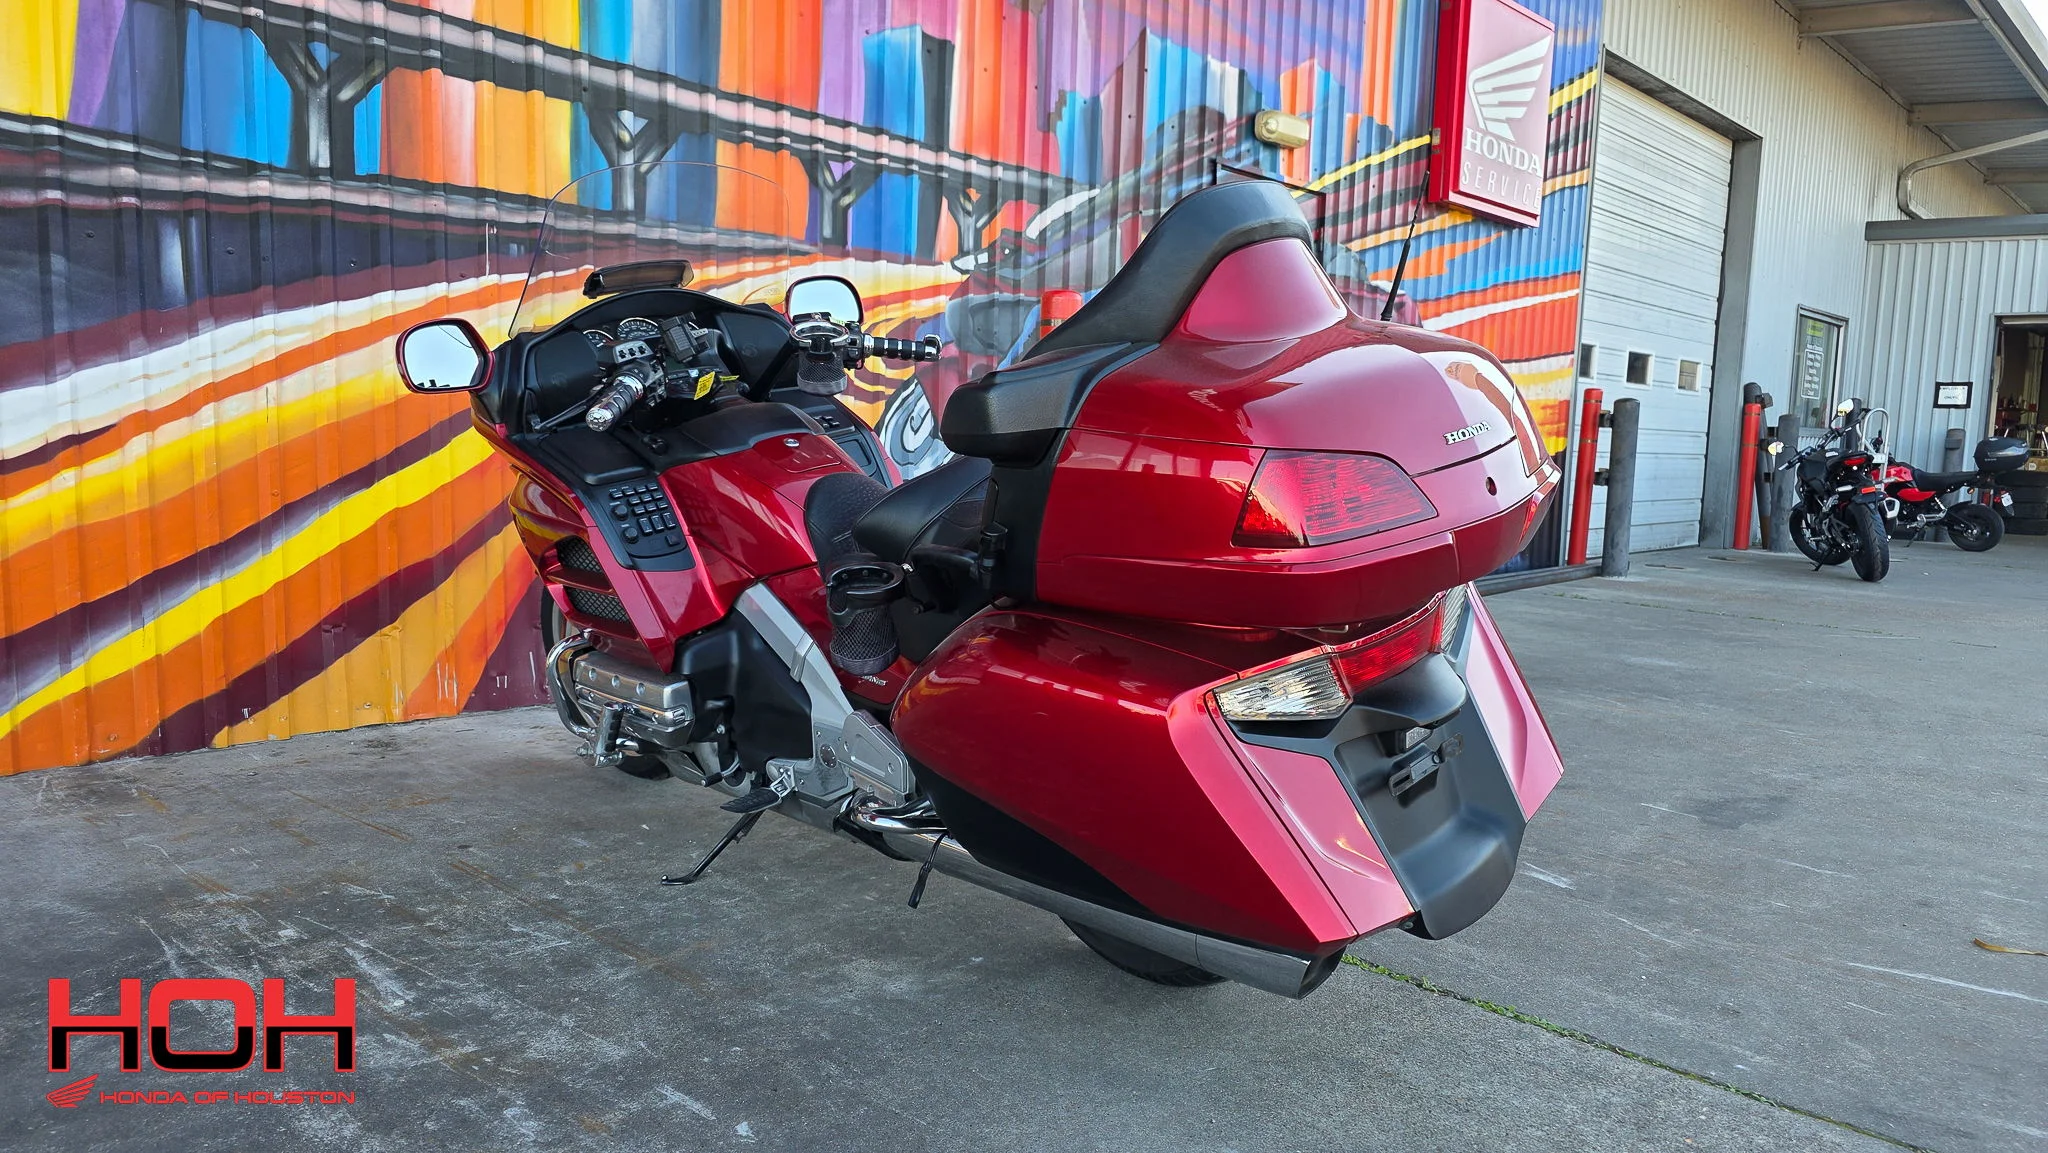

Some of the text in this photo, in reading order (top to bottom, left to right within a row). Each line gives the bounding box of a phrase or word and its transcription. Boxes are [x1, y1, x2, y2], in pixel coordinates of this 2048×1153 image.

[1464, 128, 1542, 178] HONDA
[1462, 161, 1541, 208] SERVICE
[1443, 420, 1492, 445] HONDA
